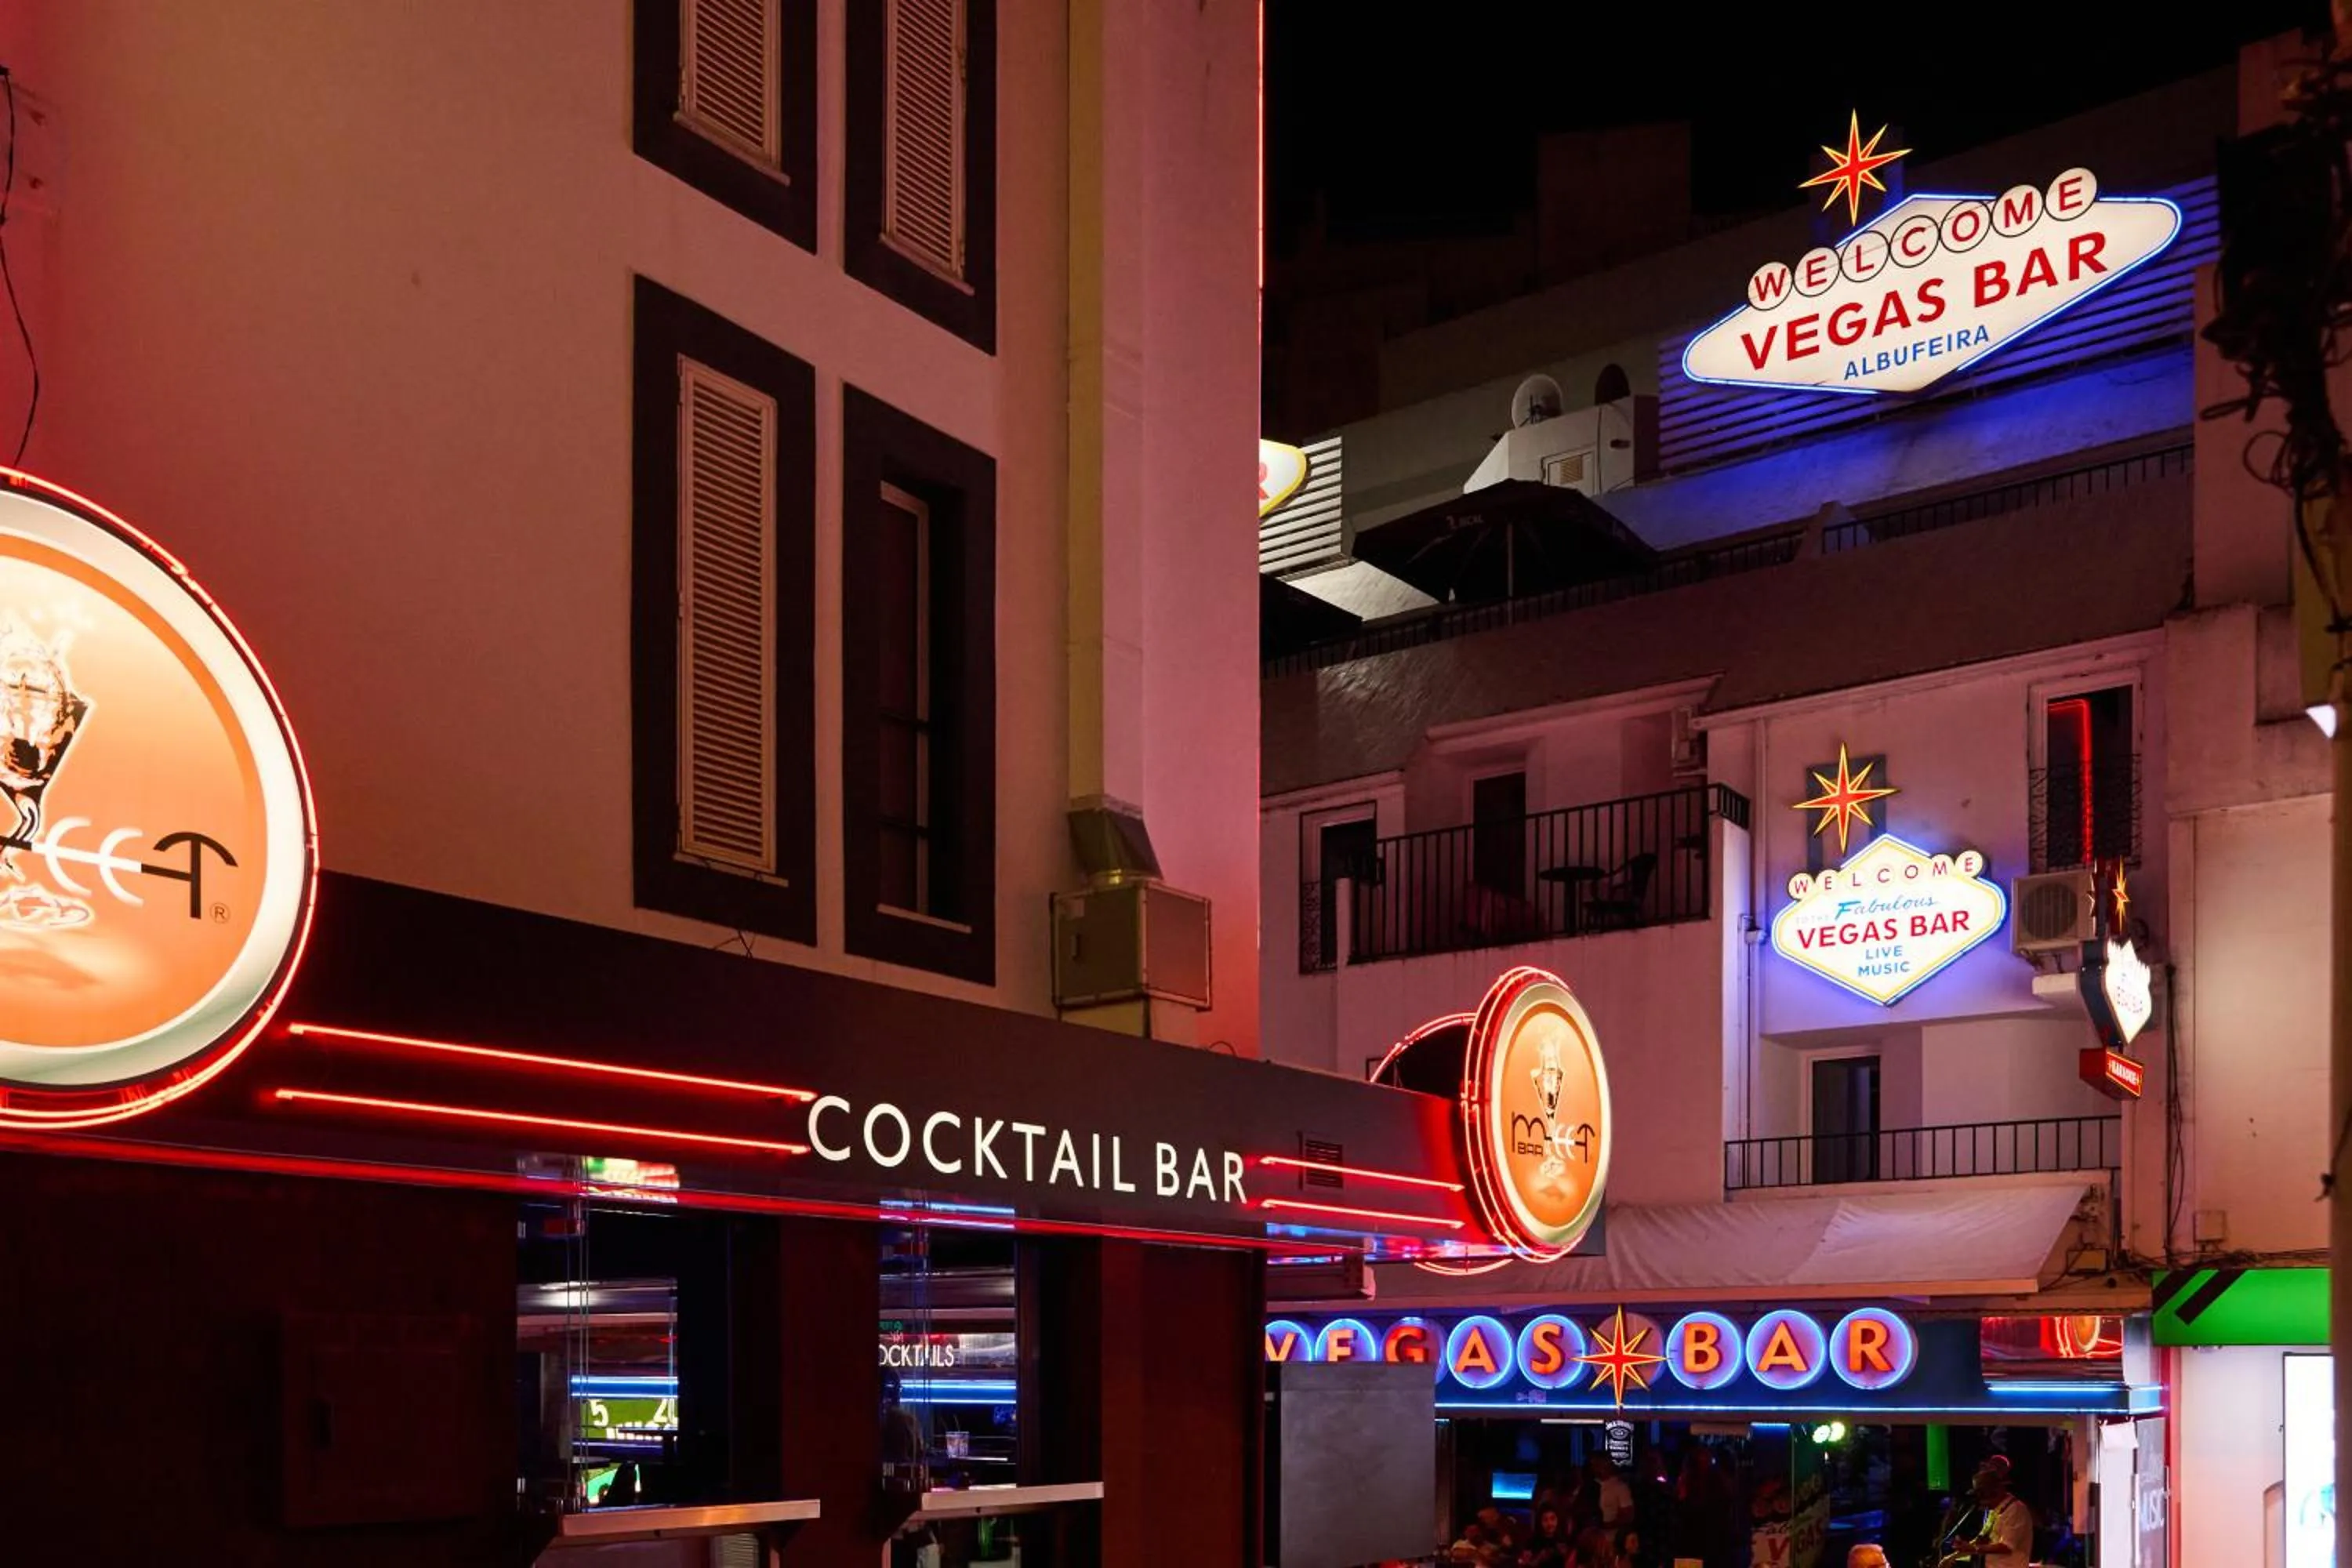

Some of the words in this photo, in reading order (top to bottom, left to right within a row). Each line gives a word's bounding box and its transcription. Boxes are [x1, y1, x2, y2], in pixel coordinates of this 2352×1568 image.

[1755, 176, 2083, 302] WELCOME
[1740, 278, 1947, 372] VEGAS
[1973, 231, 2109, 308] BAR
[1843, 325, 1990, 381] ALBUFEIRA
[1795, 857, 1973, 895] WELCOME
[1835, 895, 1939, 921] Fabulous
[1797, 918, 1898, 949] VEGAS
[1910, 909, 1970, 938] BAR
[1857, 961, 1911, 977] MUSIC
[1865, 945, 1904, 960] LIVE
[808, 1095, 1136, 1192] COCKTAIL
[1155, 1141, 1248, 1204] BAR
[879, 1345, 955, 1367] OCKTAILS
[1683, 1319, 1894, 1374] BAR
